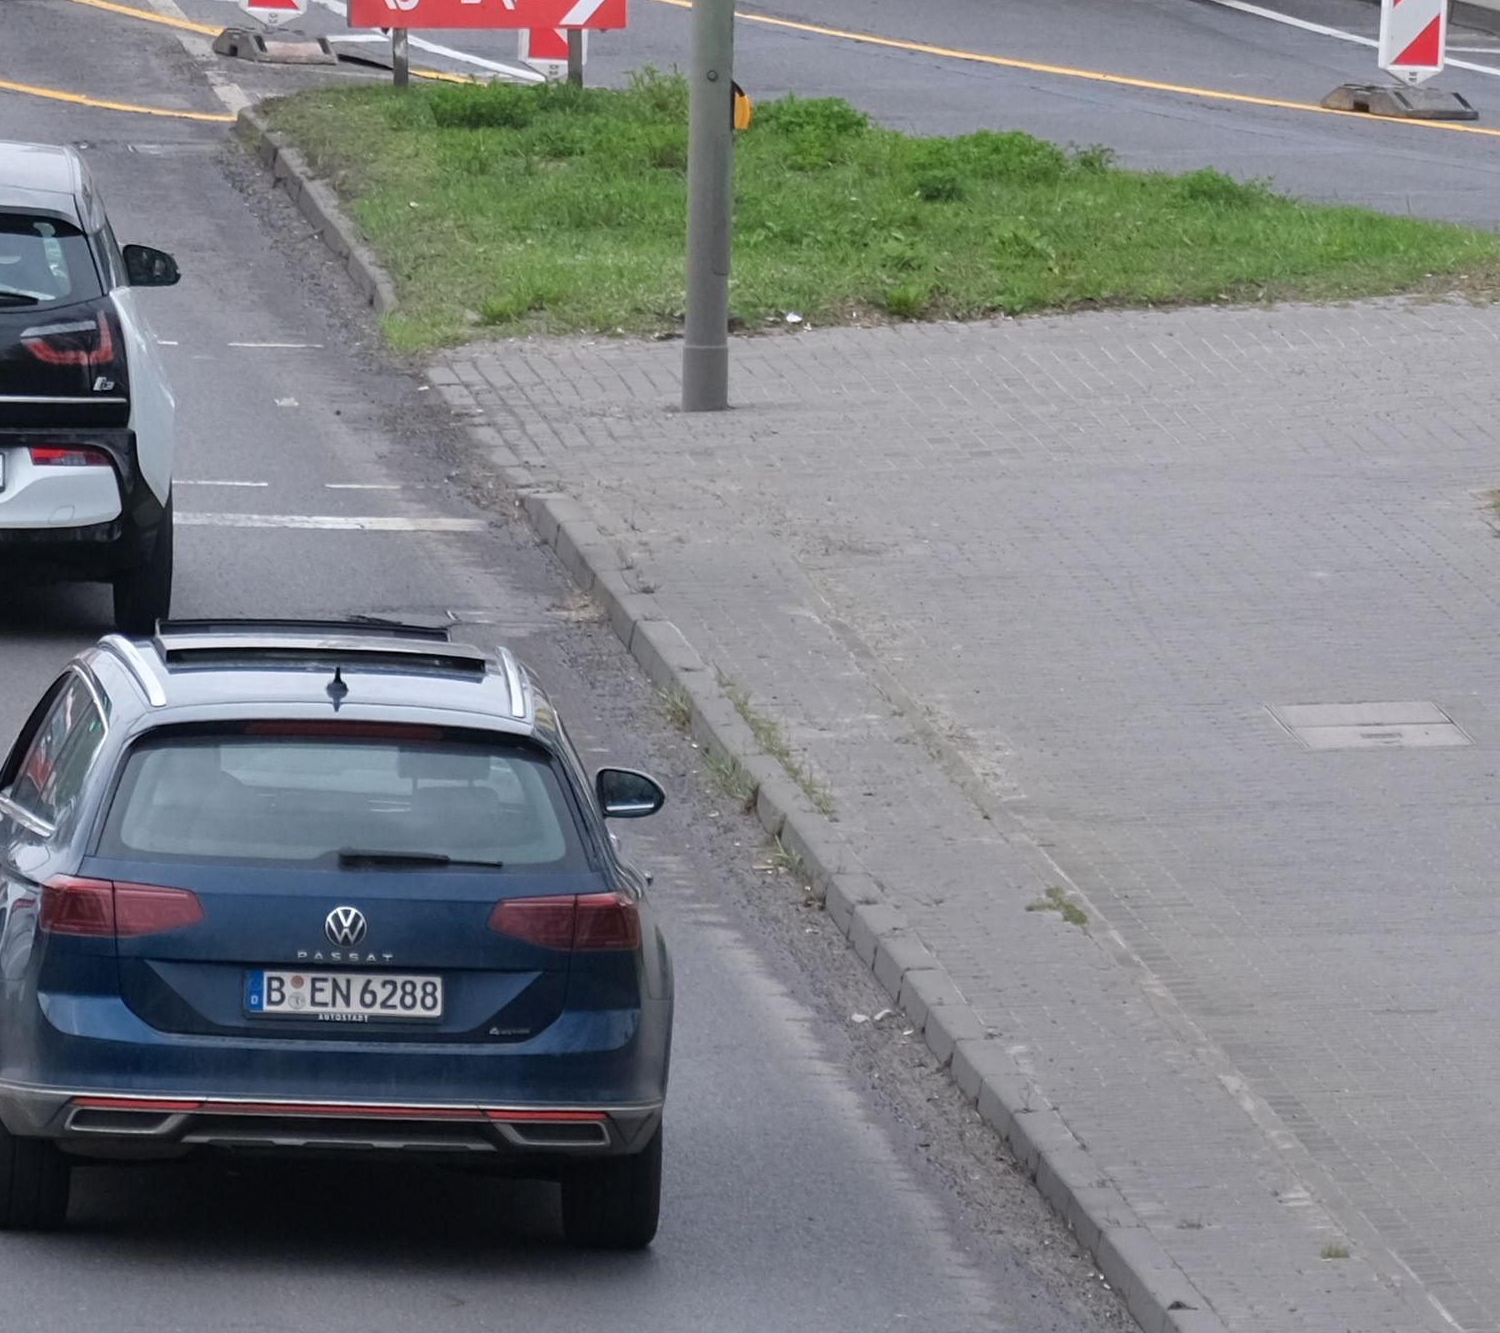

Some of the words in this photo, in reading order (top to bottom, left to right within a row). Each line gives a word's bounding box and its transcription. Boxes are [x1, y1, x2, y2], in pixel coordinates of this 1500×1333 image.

[297, 951, 395, 963] PASSAT
[267, 976, 286, 1008] B
[309, 977, 352, 1009] EN
[358, 978, 438, 1012] 6288
